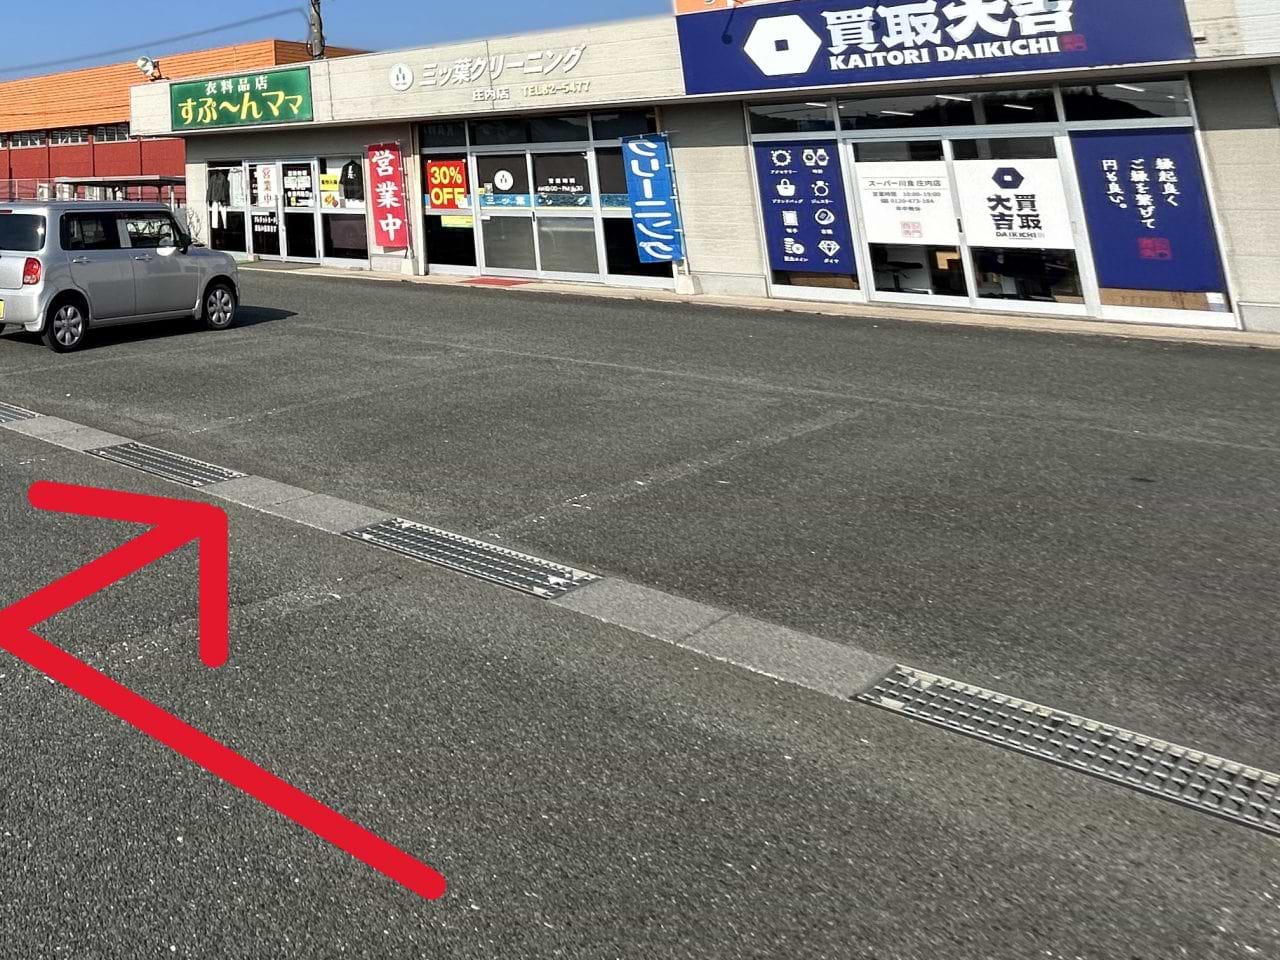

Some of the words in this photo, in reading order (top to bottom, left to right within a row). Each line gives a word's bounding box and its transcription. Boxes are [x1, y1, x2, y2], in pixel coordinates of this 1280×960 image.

[829, 49, 930, 70] KAITORI
[936, 36, 1061, 62] DAIKICHI
[205, 75, 268, 96] 衣料品店
[472, 88, 510, 102] 庄内店
[261, 167, 272, 205] 営業中
[430, 166, 463, 185] 30%
[1101, 159, 1128, 209] 円も良い。
[1155, 157, 1181, 207] 縁起良く
[371, 149, 403, 242] 営業中
[430, 187, 465, 206] OFF
[628, 139, 675, 260] クリーニング
